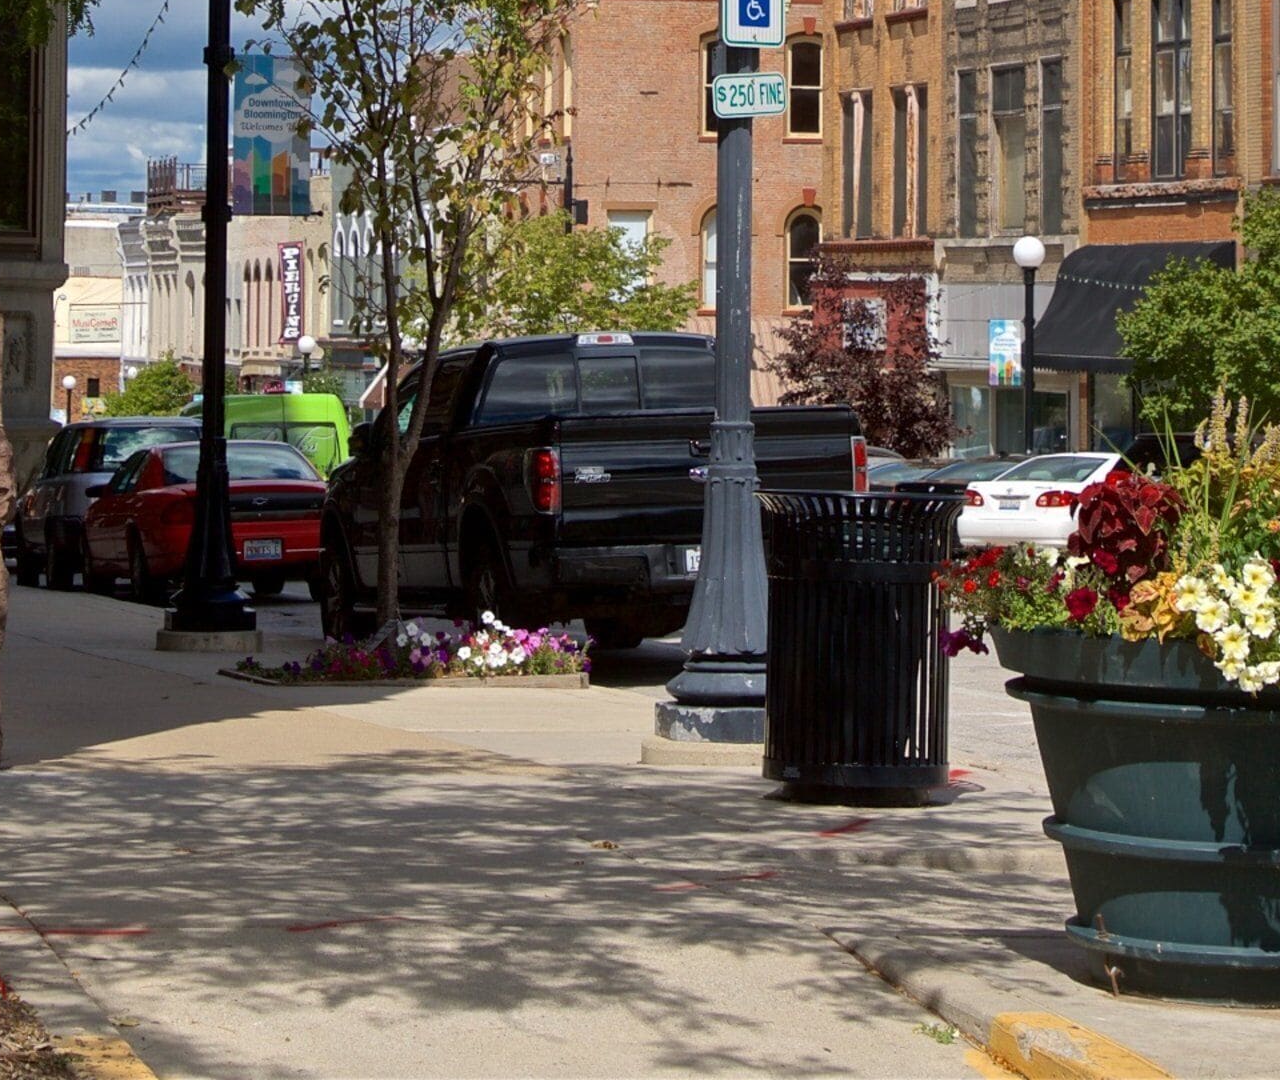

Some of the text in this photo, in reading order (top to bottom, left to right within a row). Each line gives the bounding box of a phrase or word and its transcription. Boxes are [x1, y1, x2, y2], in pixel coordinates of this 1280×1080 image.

[760, 82, 784, 105] FINE
[243, 109, 301, 120] Bloomington
[282, 247, 301, 338] PIERCING
